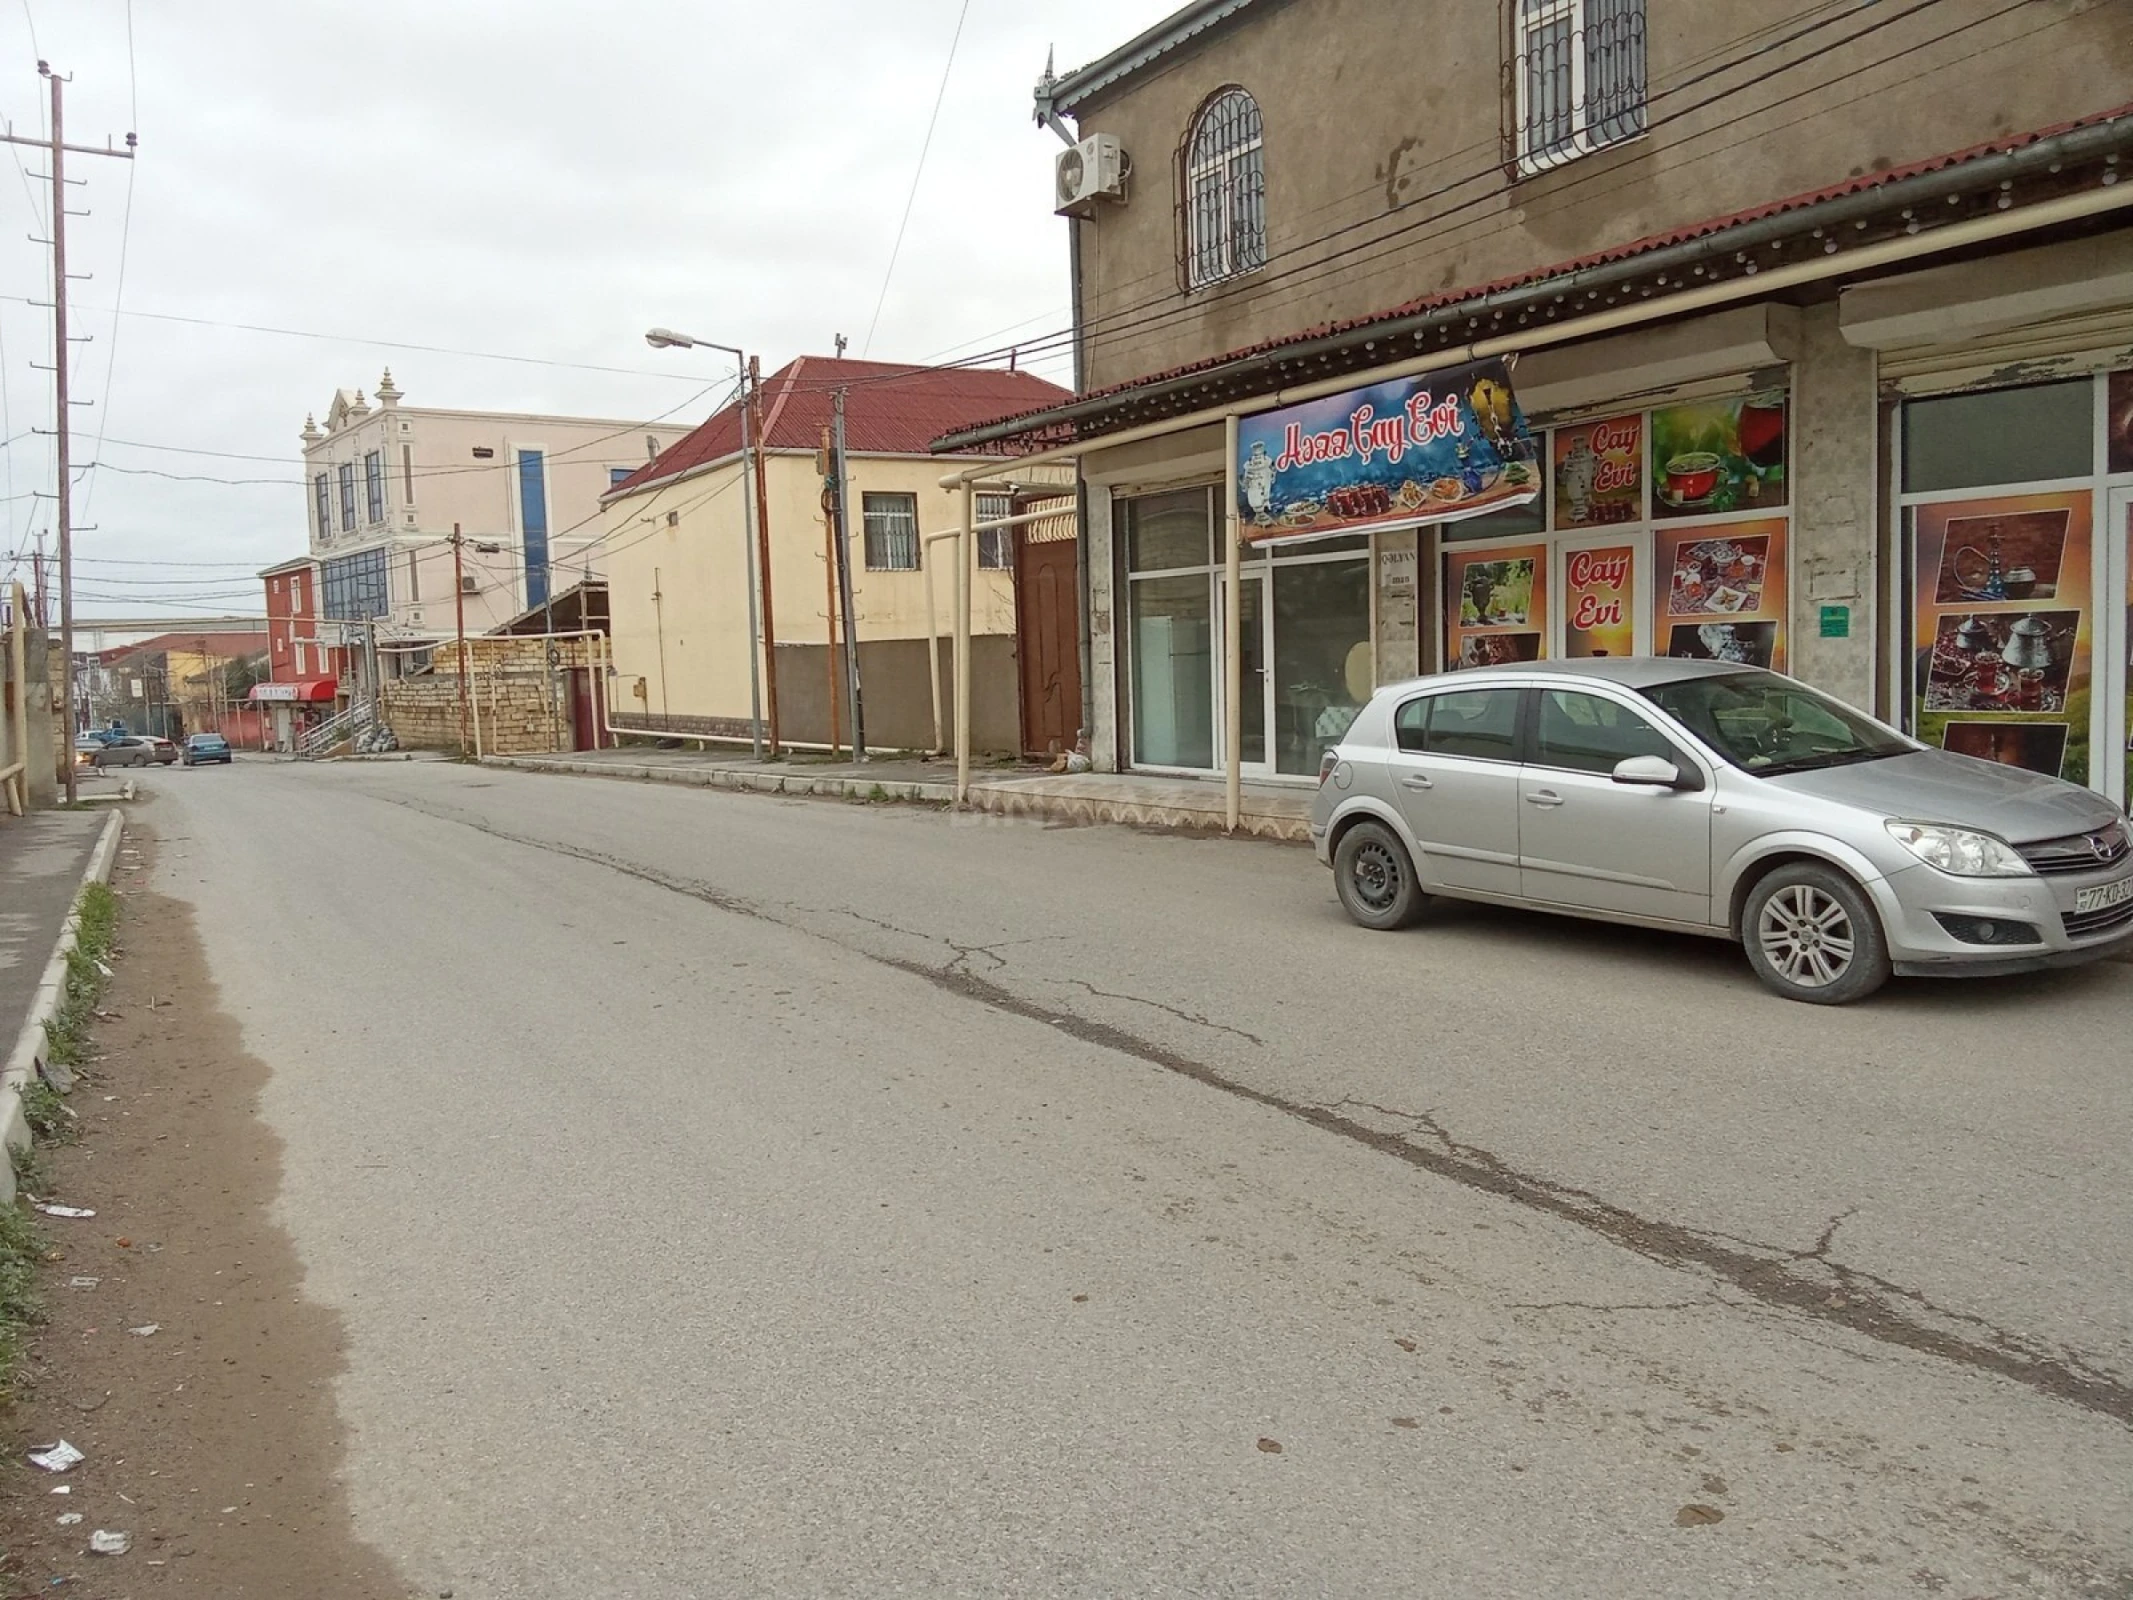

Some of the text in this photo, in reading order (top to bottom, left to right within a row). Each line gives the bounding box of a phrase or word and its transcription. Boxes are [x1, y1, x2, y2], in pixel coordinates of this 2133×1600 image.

[1351, 404, 1411, 465] Çay
[1406, 391, 1464, 446] Evi
[1591, 424, 1639, 457] Çay
[1594, 460, 1636, 492] Evi
[1569, 552, 1629, 592] Çay
[1573, 593, 1624, 630] Evi
